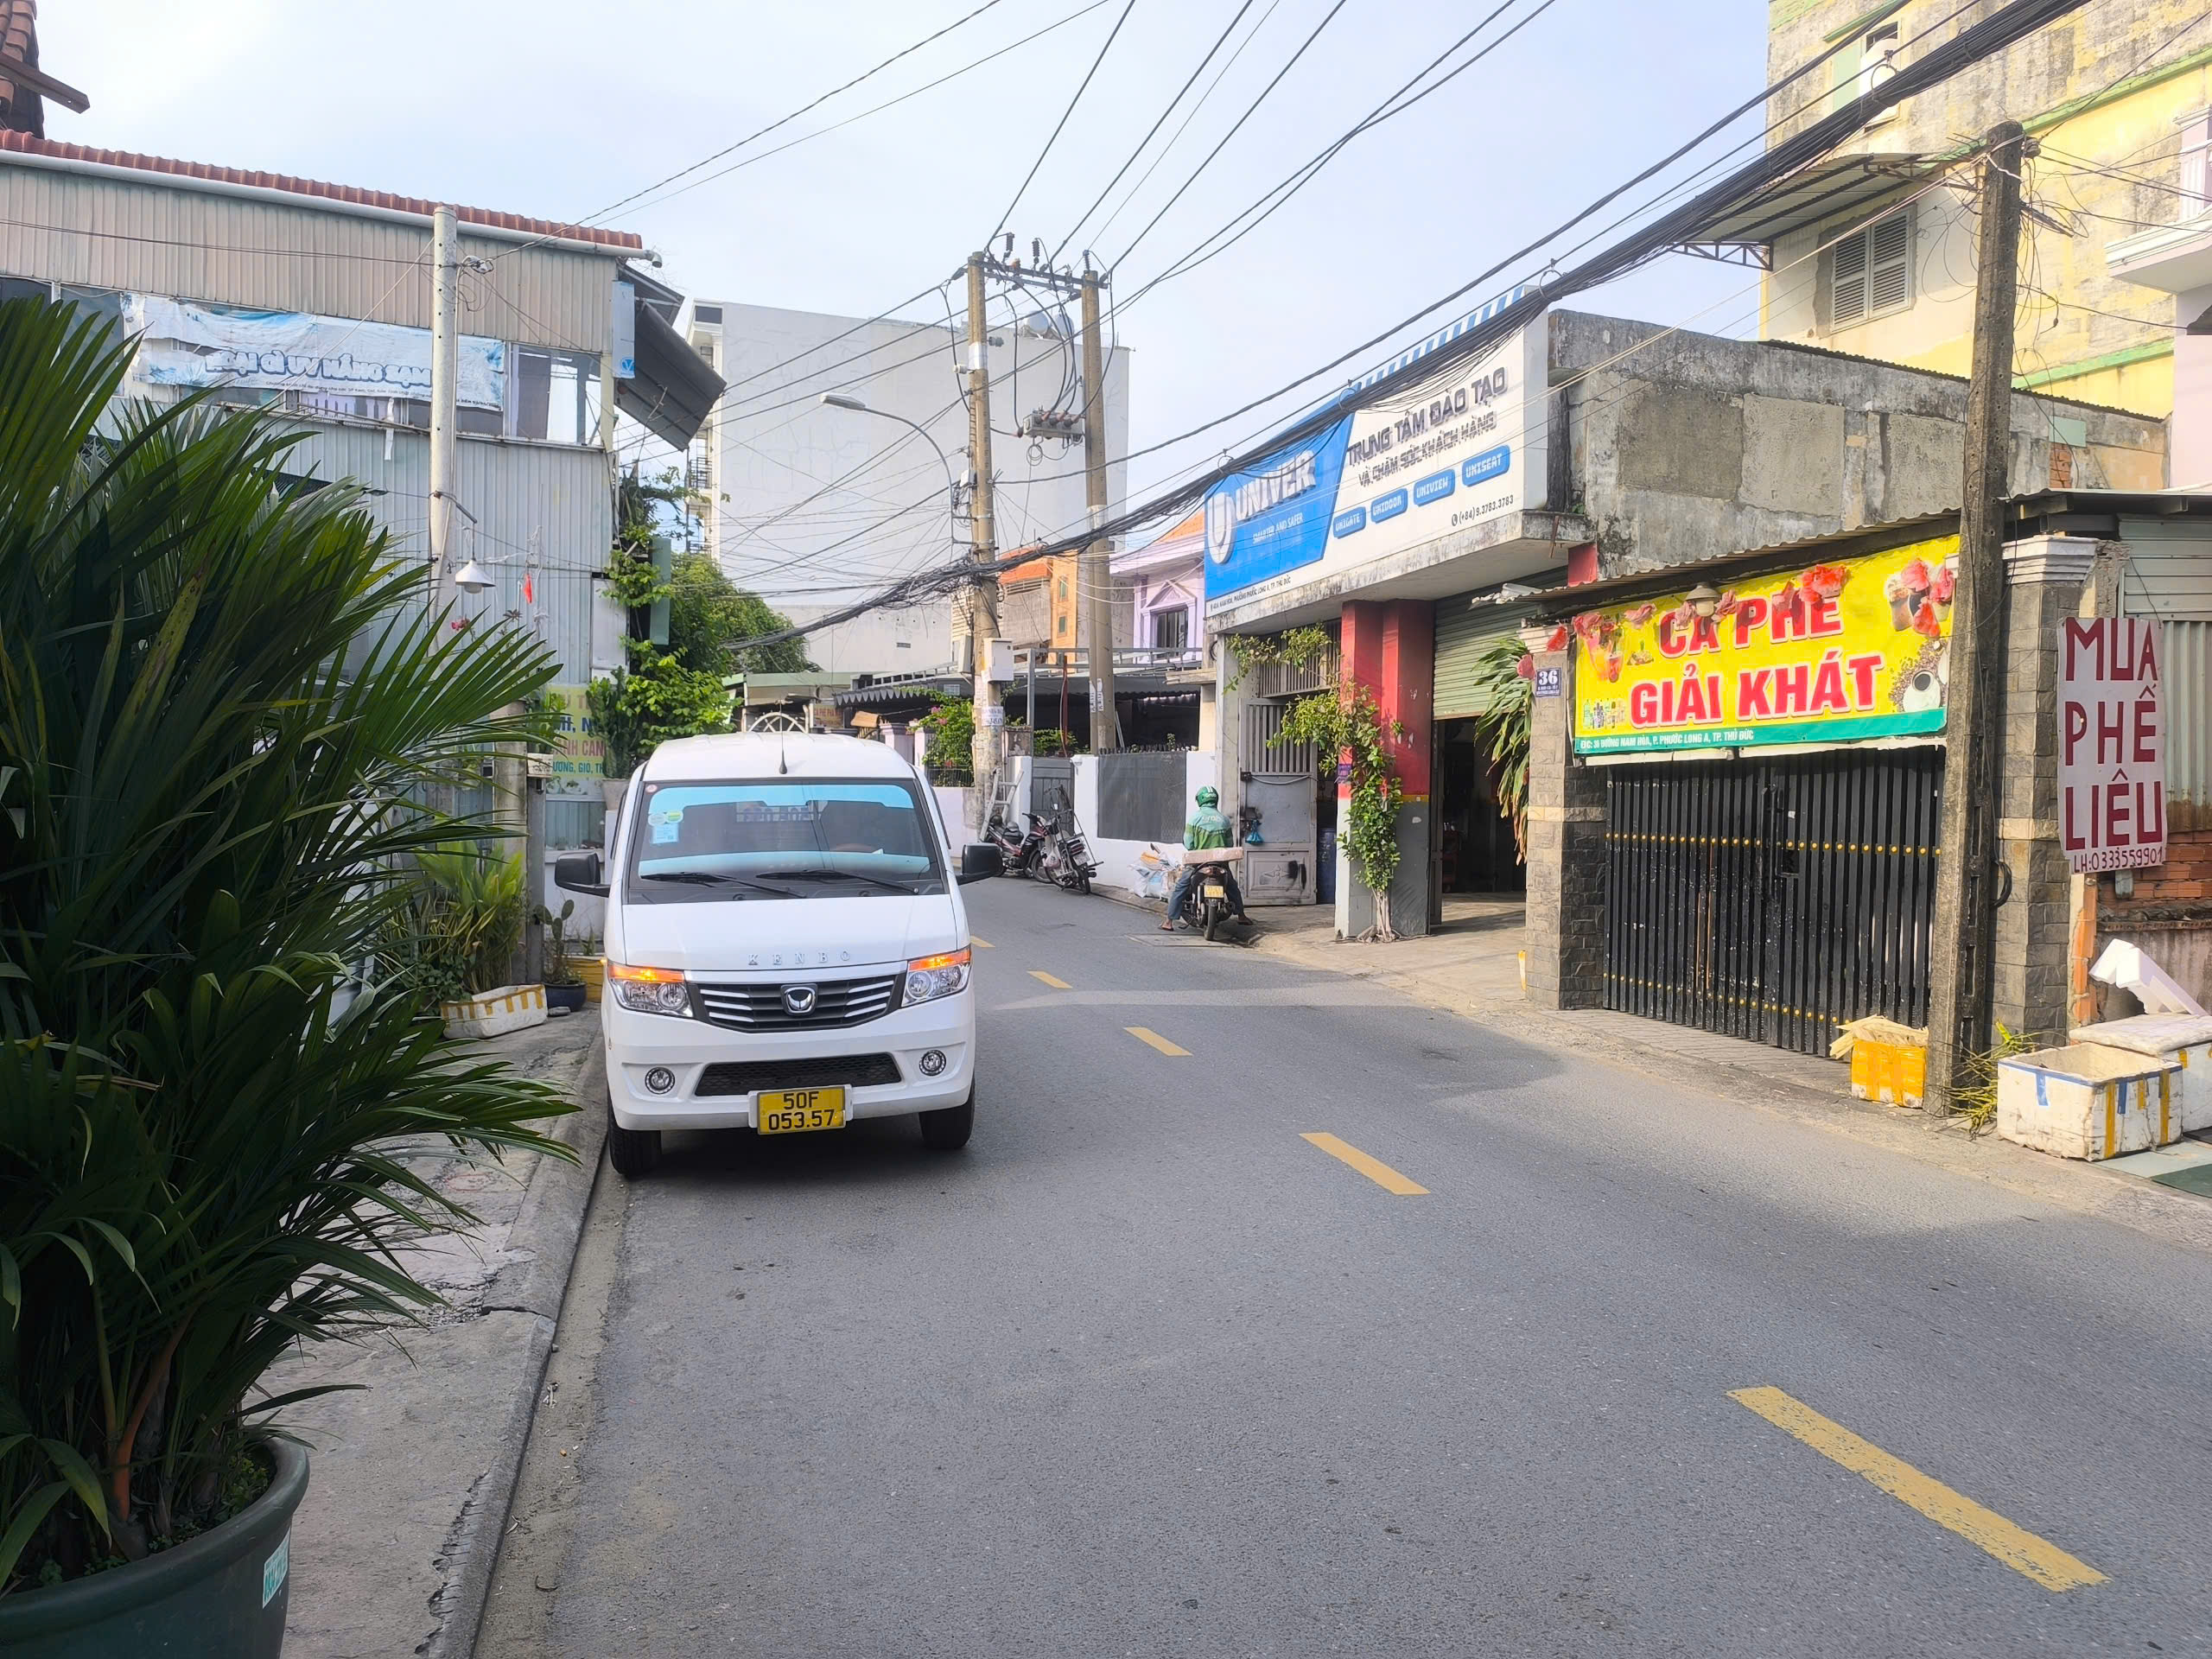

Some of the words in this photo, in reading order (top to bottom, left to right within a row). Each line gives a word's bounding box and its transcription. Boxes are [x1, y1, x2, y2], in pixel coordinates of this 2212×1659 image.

[1346, 427, 1392, 467] TRUNG
[1394, 409, 1426, 442] TÂM
[1430, 388, 1467, 426] ĐÀO
[1471, 366, 1507, 407] TẠO
[1465, 453, 1503, 478] UNISEAT
[1236, 450, 1316, 521] UNIVER
[1416, 477, 1448, 499] UNIVIEW
[2065, 617, 2158, 681] MUA
[1538, 670, 1558, 685] 36
[1630, 663, 1723, 729] GIẢI
[1737, 649, 1885, 721] KHÁT
[2065, 683, 2158, 766] PHẾ
[1620, 738, 1637, 747] NAM
[1659, 734, 1682, 745] PHƯỚC
[1684, 734, 1703, 744] LONG
[1713, 732, 1722, 742] TP.
[1723, 728, 1738, 741] THỦ
[1739, 728, 1754, 741] ĐỨC
[748, 950, 850, 966] KENBO
[783, 1091, 820, 1110] 50F
[768, 1109, 835, 1130] 053.57
